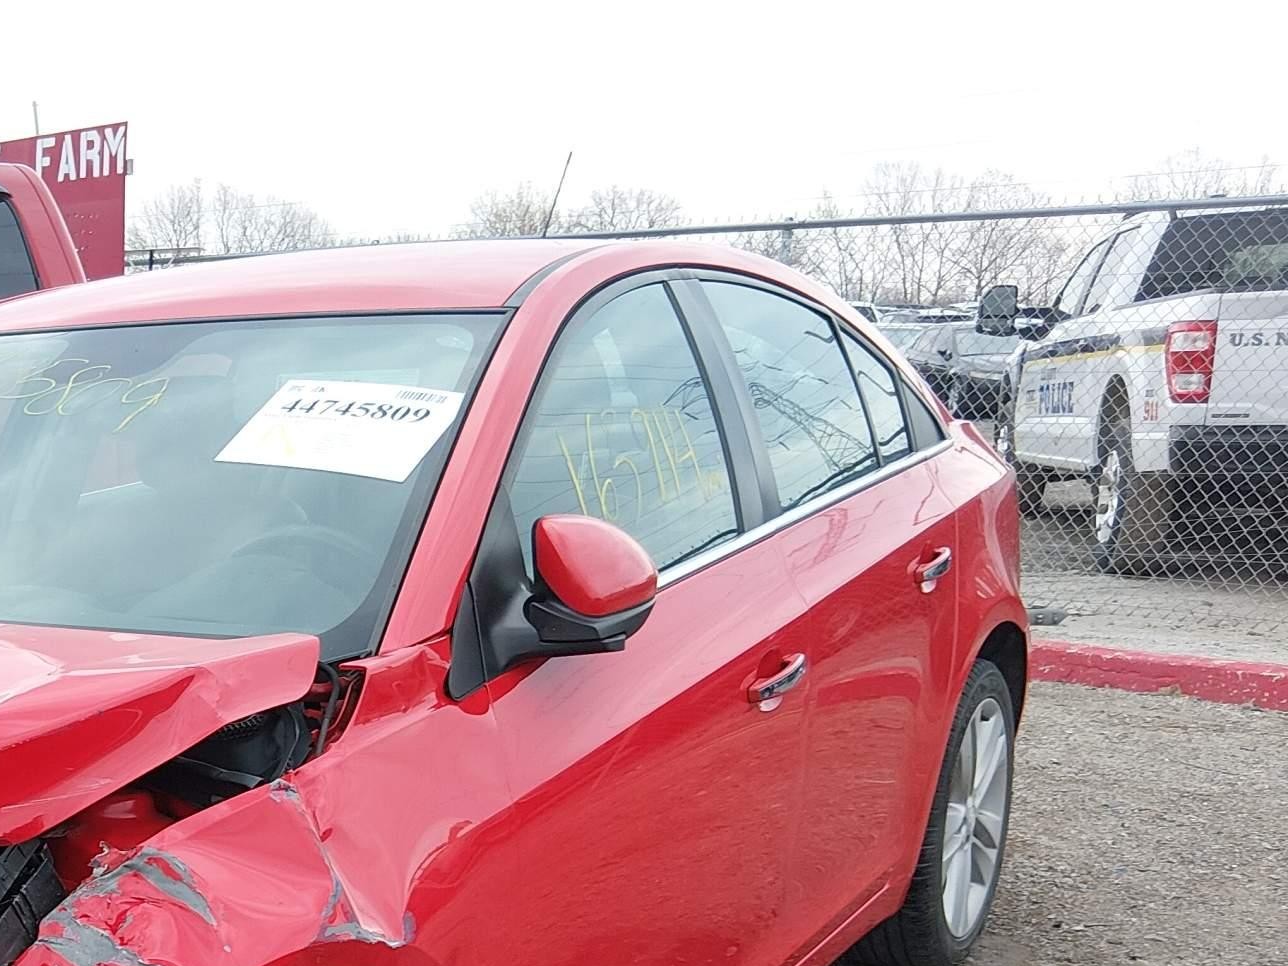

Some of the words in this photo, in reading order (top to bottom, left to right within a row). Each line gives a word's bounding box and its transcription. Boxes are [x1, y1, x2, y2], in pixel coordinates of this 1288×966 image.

[35, 125, 126, 183] FARM
[1229, 332, 1270, 347] U.S.
[281, 398, 431, 423] 44745809
[1038, 381, 1074, 415] POLICE
